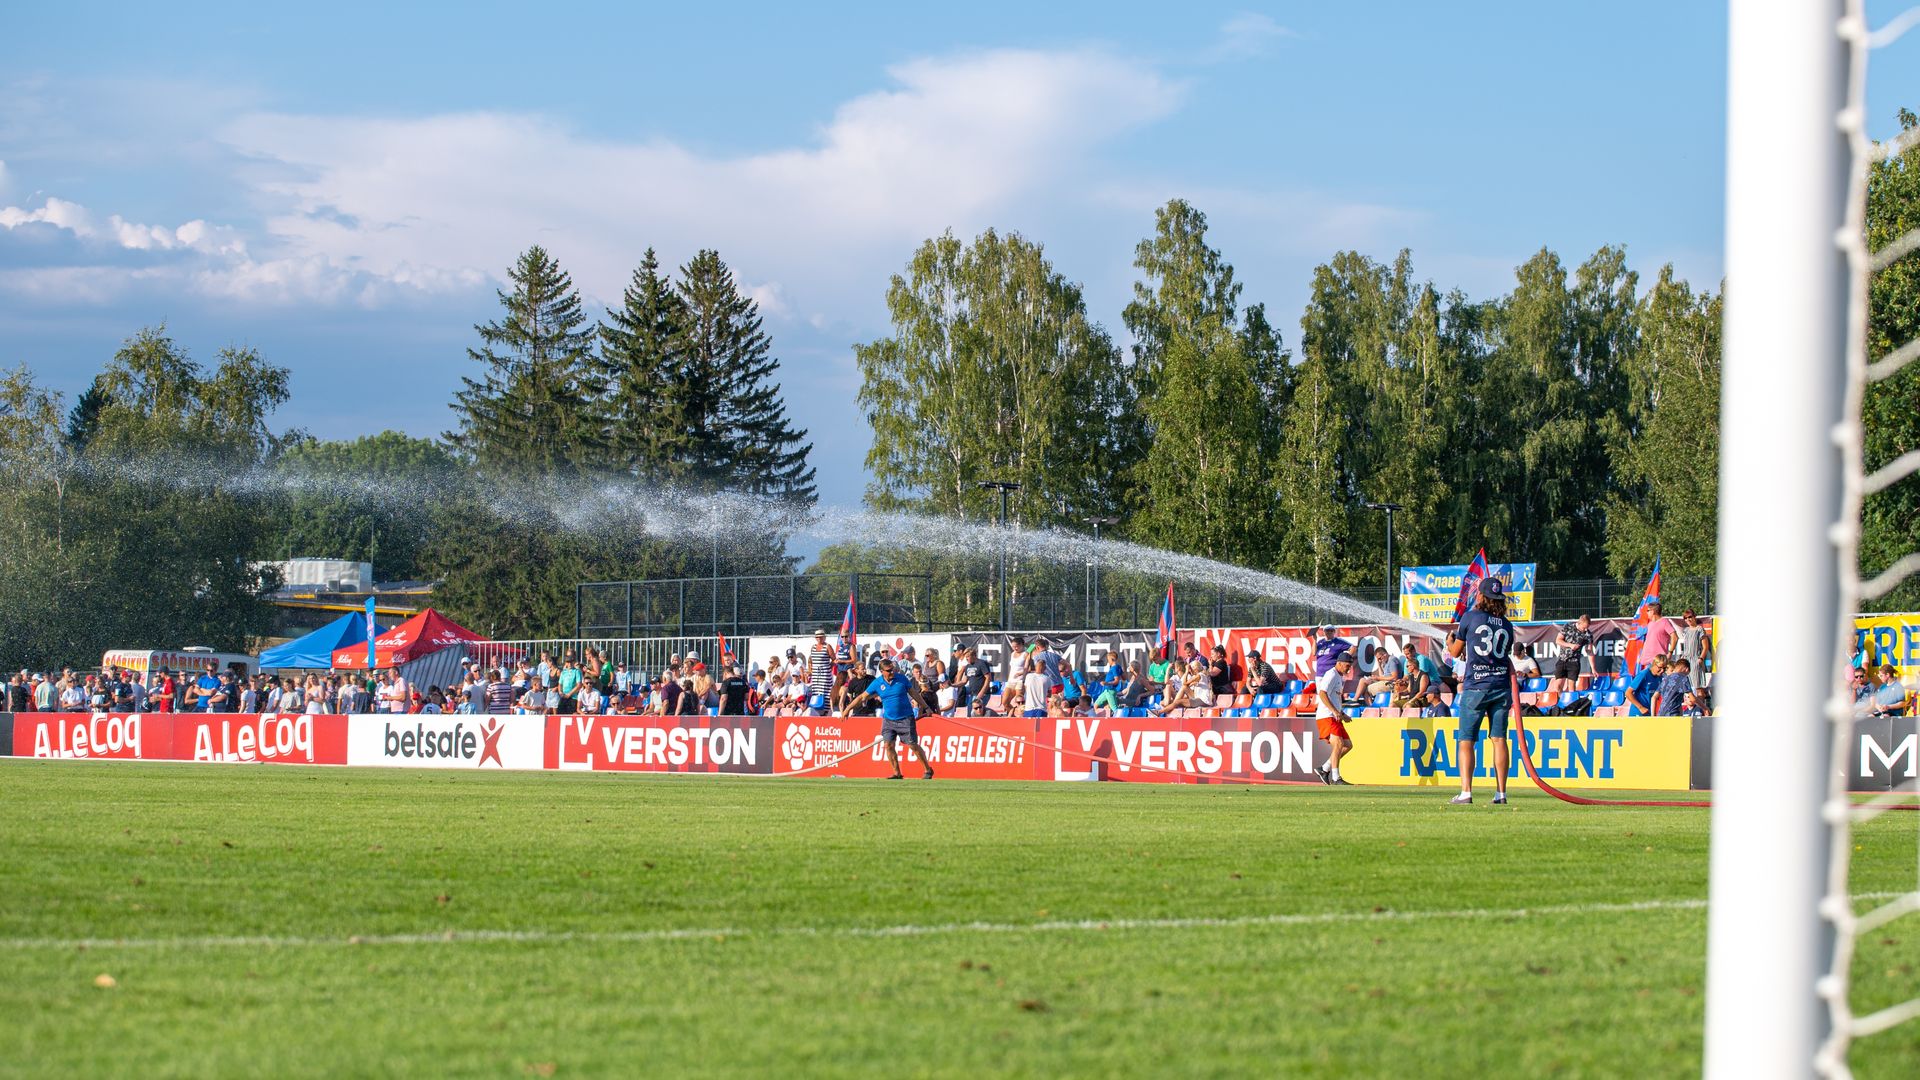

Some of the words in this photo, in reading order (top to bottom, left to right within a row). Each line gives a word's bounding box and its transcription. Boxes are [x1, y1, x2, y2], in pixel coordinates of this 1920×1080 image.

[1425, 573, 1461, 588] Слава
[1413, 610, 1430, 619] ARE
[1433, 610, 1454, 619] WITH
[1420, 598, 1446, 606] PAIDE
[1487, 616, 1503, 627] ARTO
[1241, 634, 1411, 677] VERON
[1473, 624, 1509, 659] 30
[34, 713, 141, 758] A.LeCoq
[194, 713, 314, 762] A.LeCoq
[385, 722, 477, 759] betsafe
[602, 727, 757, 765] VERSTON
[814, 726, 841, 738] A.LeCoq
[814, 739, 861, 753] PREMIUM
[872, 735, 904, 762] OE
[945, 735, 1026, 764] SELLEST!
[1110, 730, 1313, 774] VERSTON
[1400, 729, 1623, 779] RAMRENT
